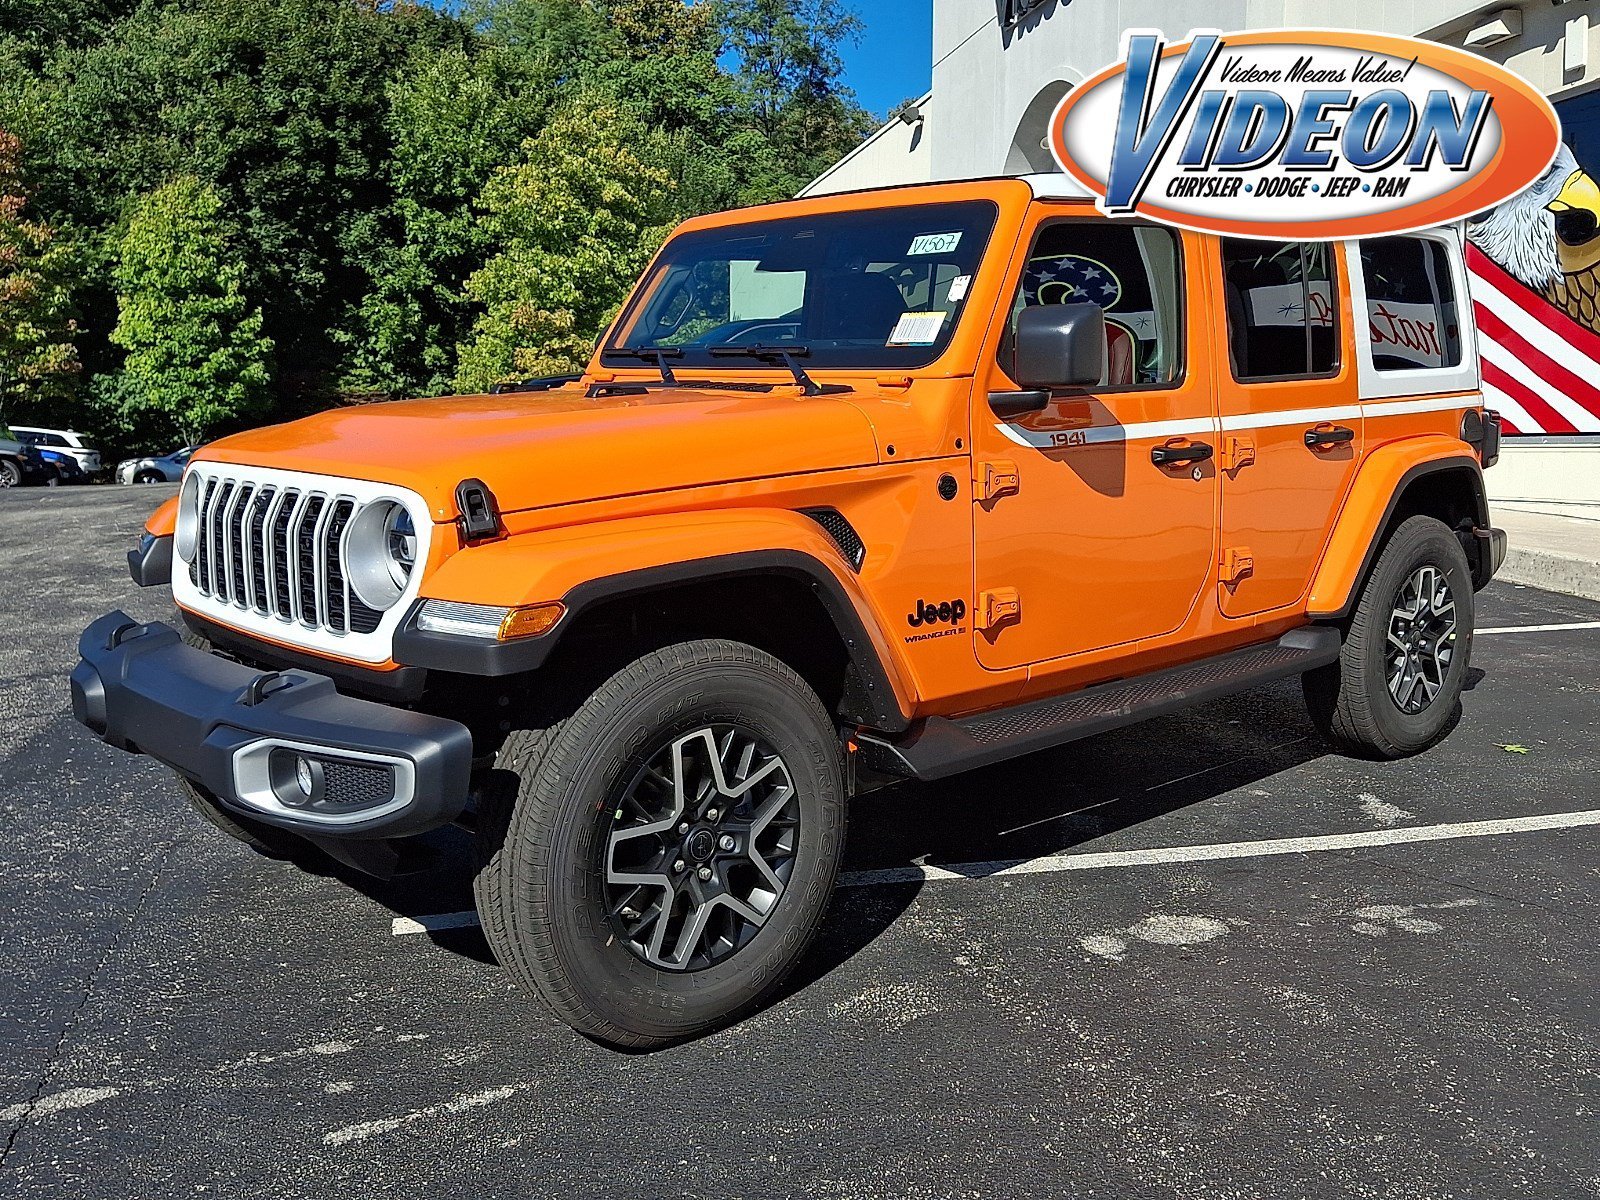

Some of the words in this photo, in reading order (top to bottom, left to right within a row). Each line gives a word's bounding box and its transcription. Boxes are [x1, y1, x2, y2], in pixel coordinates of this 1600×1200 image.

[1049, 431, 1087, 447] 1941
[907, 599, 966, 627] Jeep
[904, 628, 957, 643] WRANGLER
